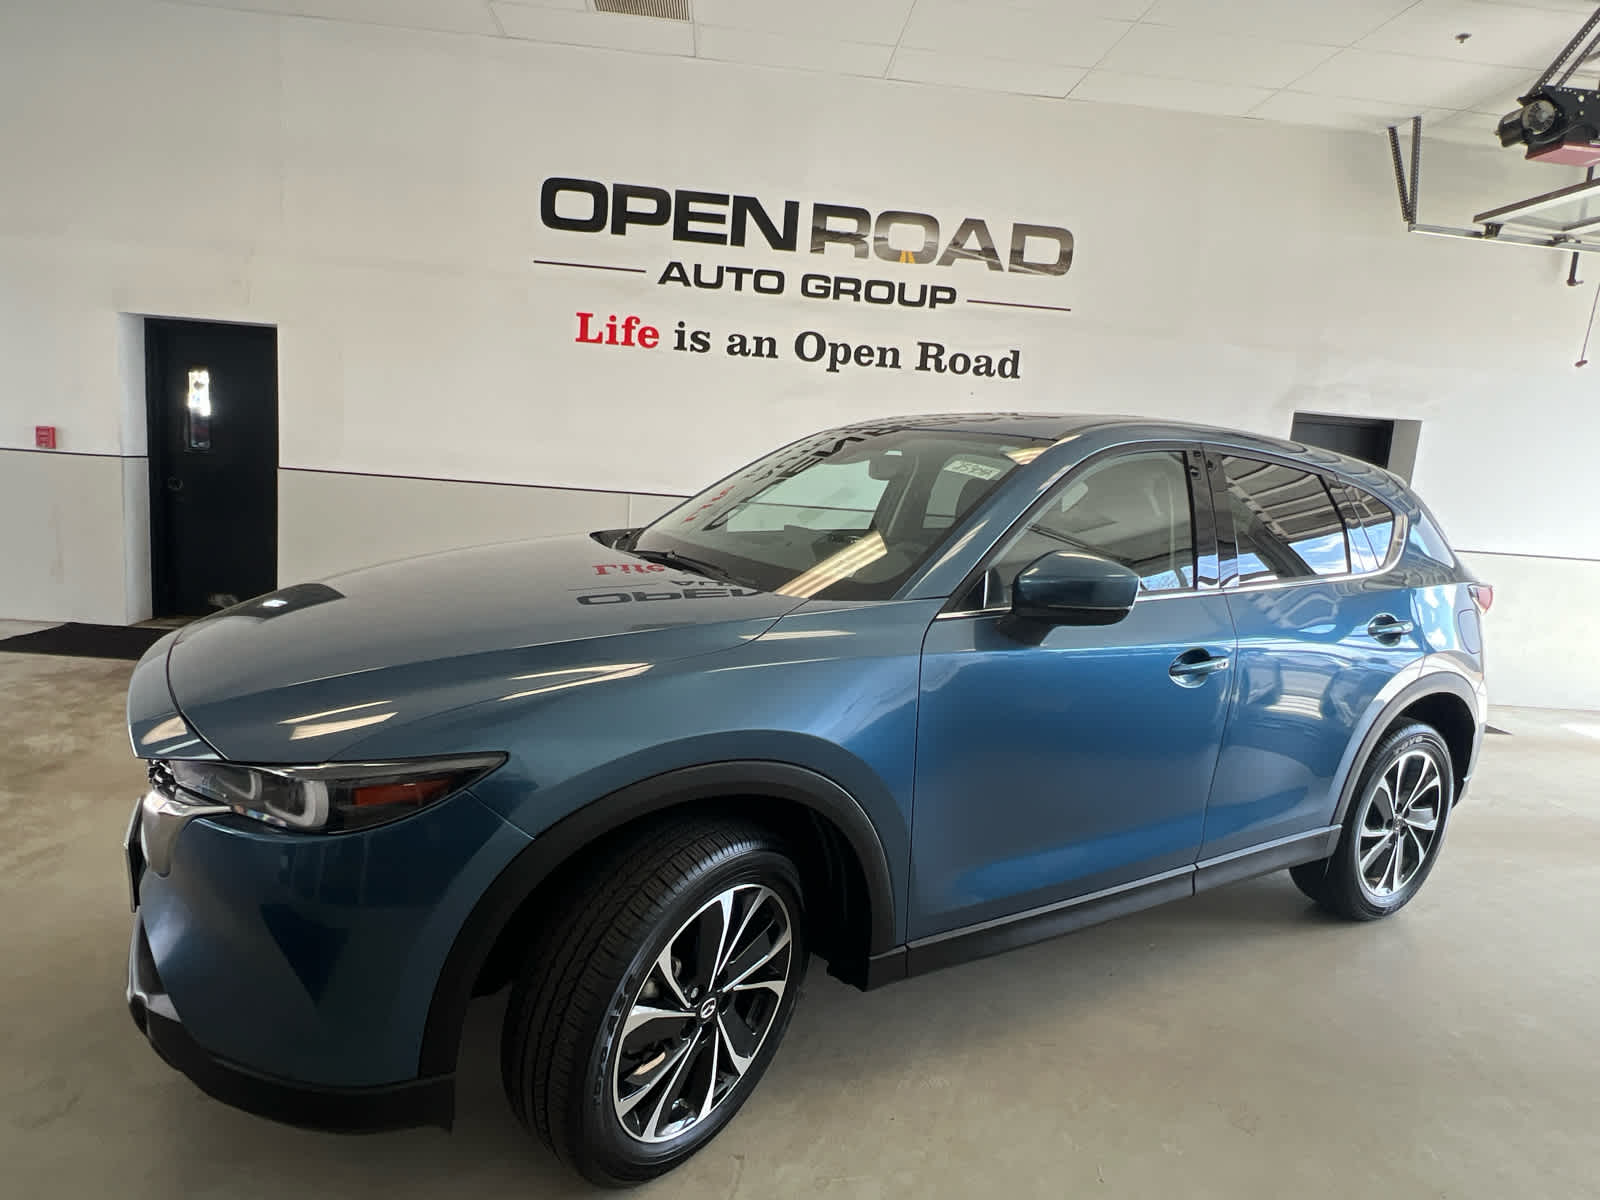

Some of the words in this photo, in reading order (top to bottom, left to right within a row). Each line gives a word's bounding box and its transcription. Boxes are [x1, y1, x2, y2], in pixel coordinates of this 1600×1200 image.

[657, 260, 785, 296] AUTO
[801, 273, 957, 309] GROUP
[575, 312, 660, 349] Life
[673, 321, 711, 354] is
[726, 334, 779, 360] an
[795, 330, 902, 373] Open
[915, 342, 1021, 380] Road
